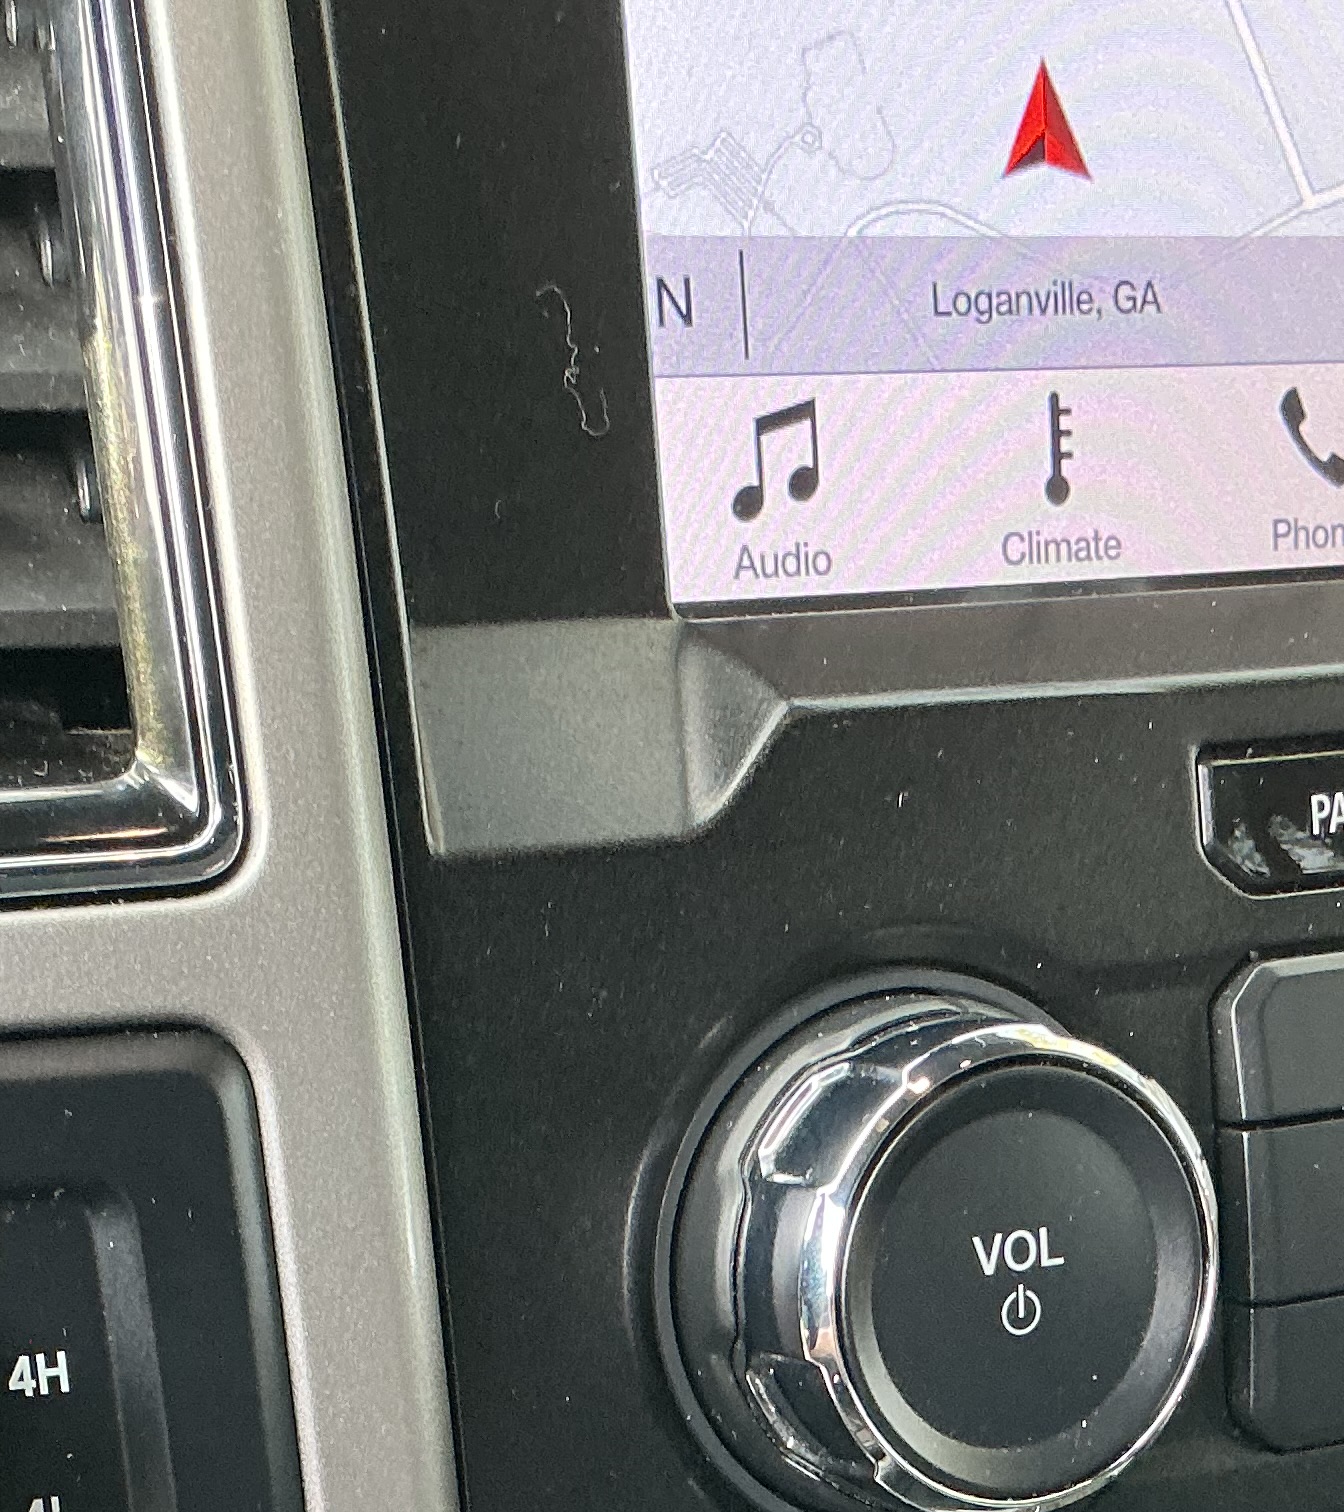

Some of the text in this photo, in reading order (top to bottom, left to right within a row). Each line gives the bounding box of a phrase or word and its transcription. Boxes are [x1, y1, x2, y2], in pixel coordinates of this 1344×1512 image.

[655, 276, 694, 328] N
[931, 279, 1163, 325] Loganville, GA
[733, 544, 834, 581] Audio
[1001, 531, 1123, 567] Climate
[971, 1226, 1065, 1276] VOL
[8, 1350, 70, 1397] 4H
